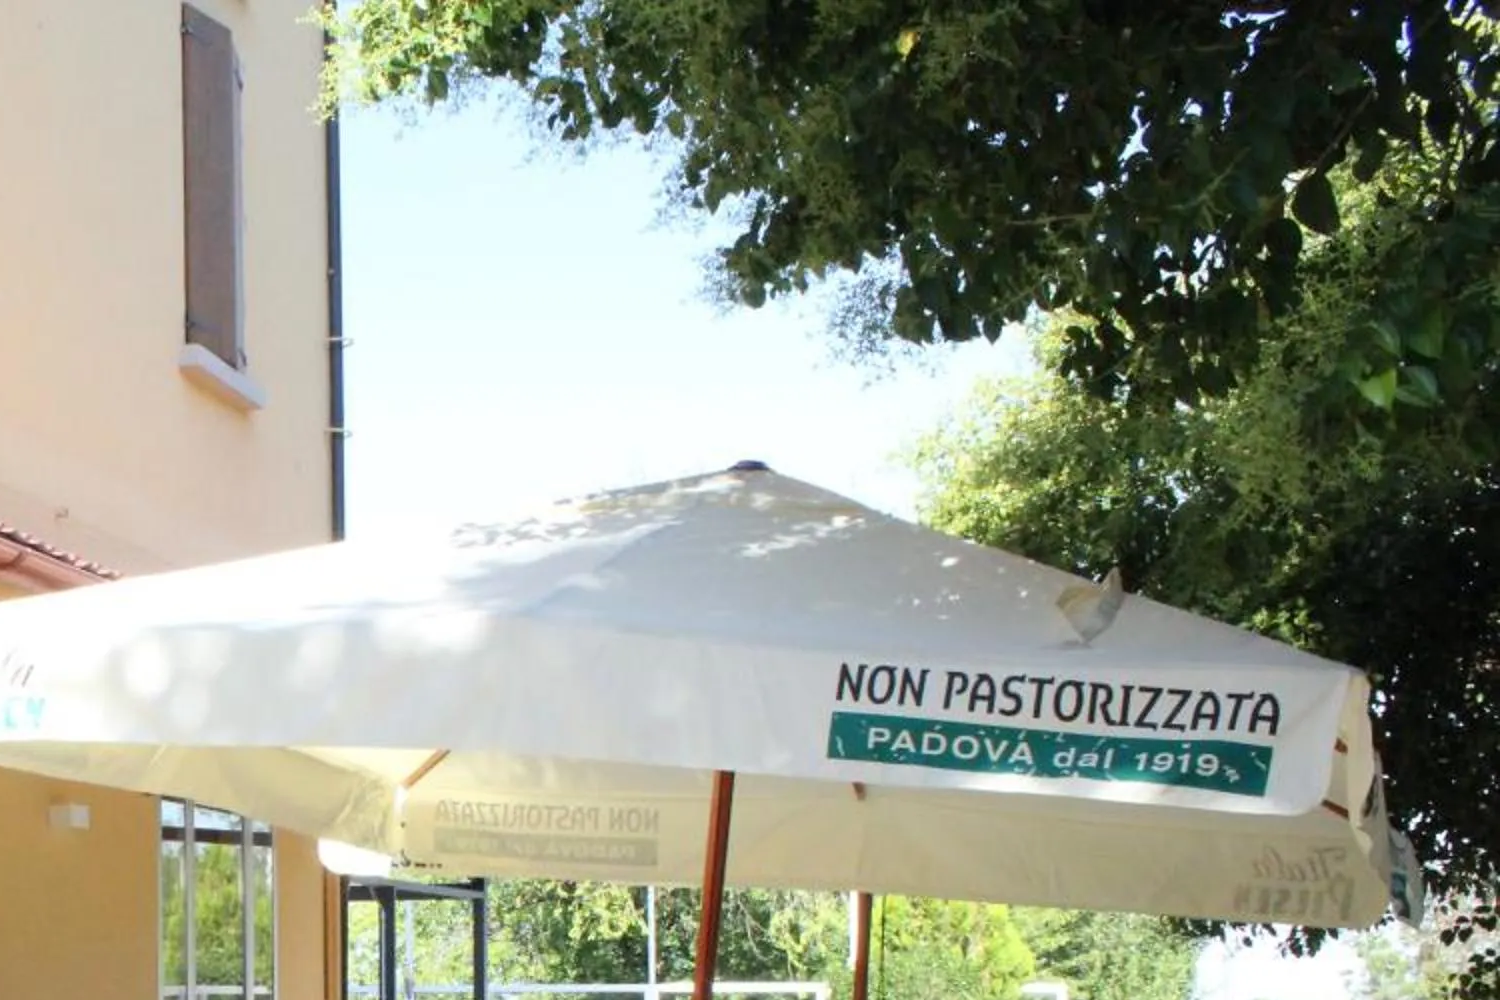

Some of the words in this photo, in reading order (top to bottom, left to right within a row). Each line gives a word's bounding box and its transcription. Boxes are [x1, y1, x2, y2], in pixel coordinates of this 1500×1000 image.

[835, 663, 931, 706] NON
[942, 671, 1282, 736] PASTORIZZATA
[866, 726, 1035, 766] PADOVA
[1052, 743, 1114, 770] dal
